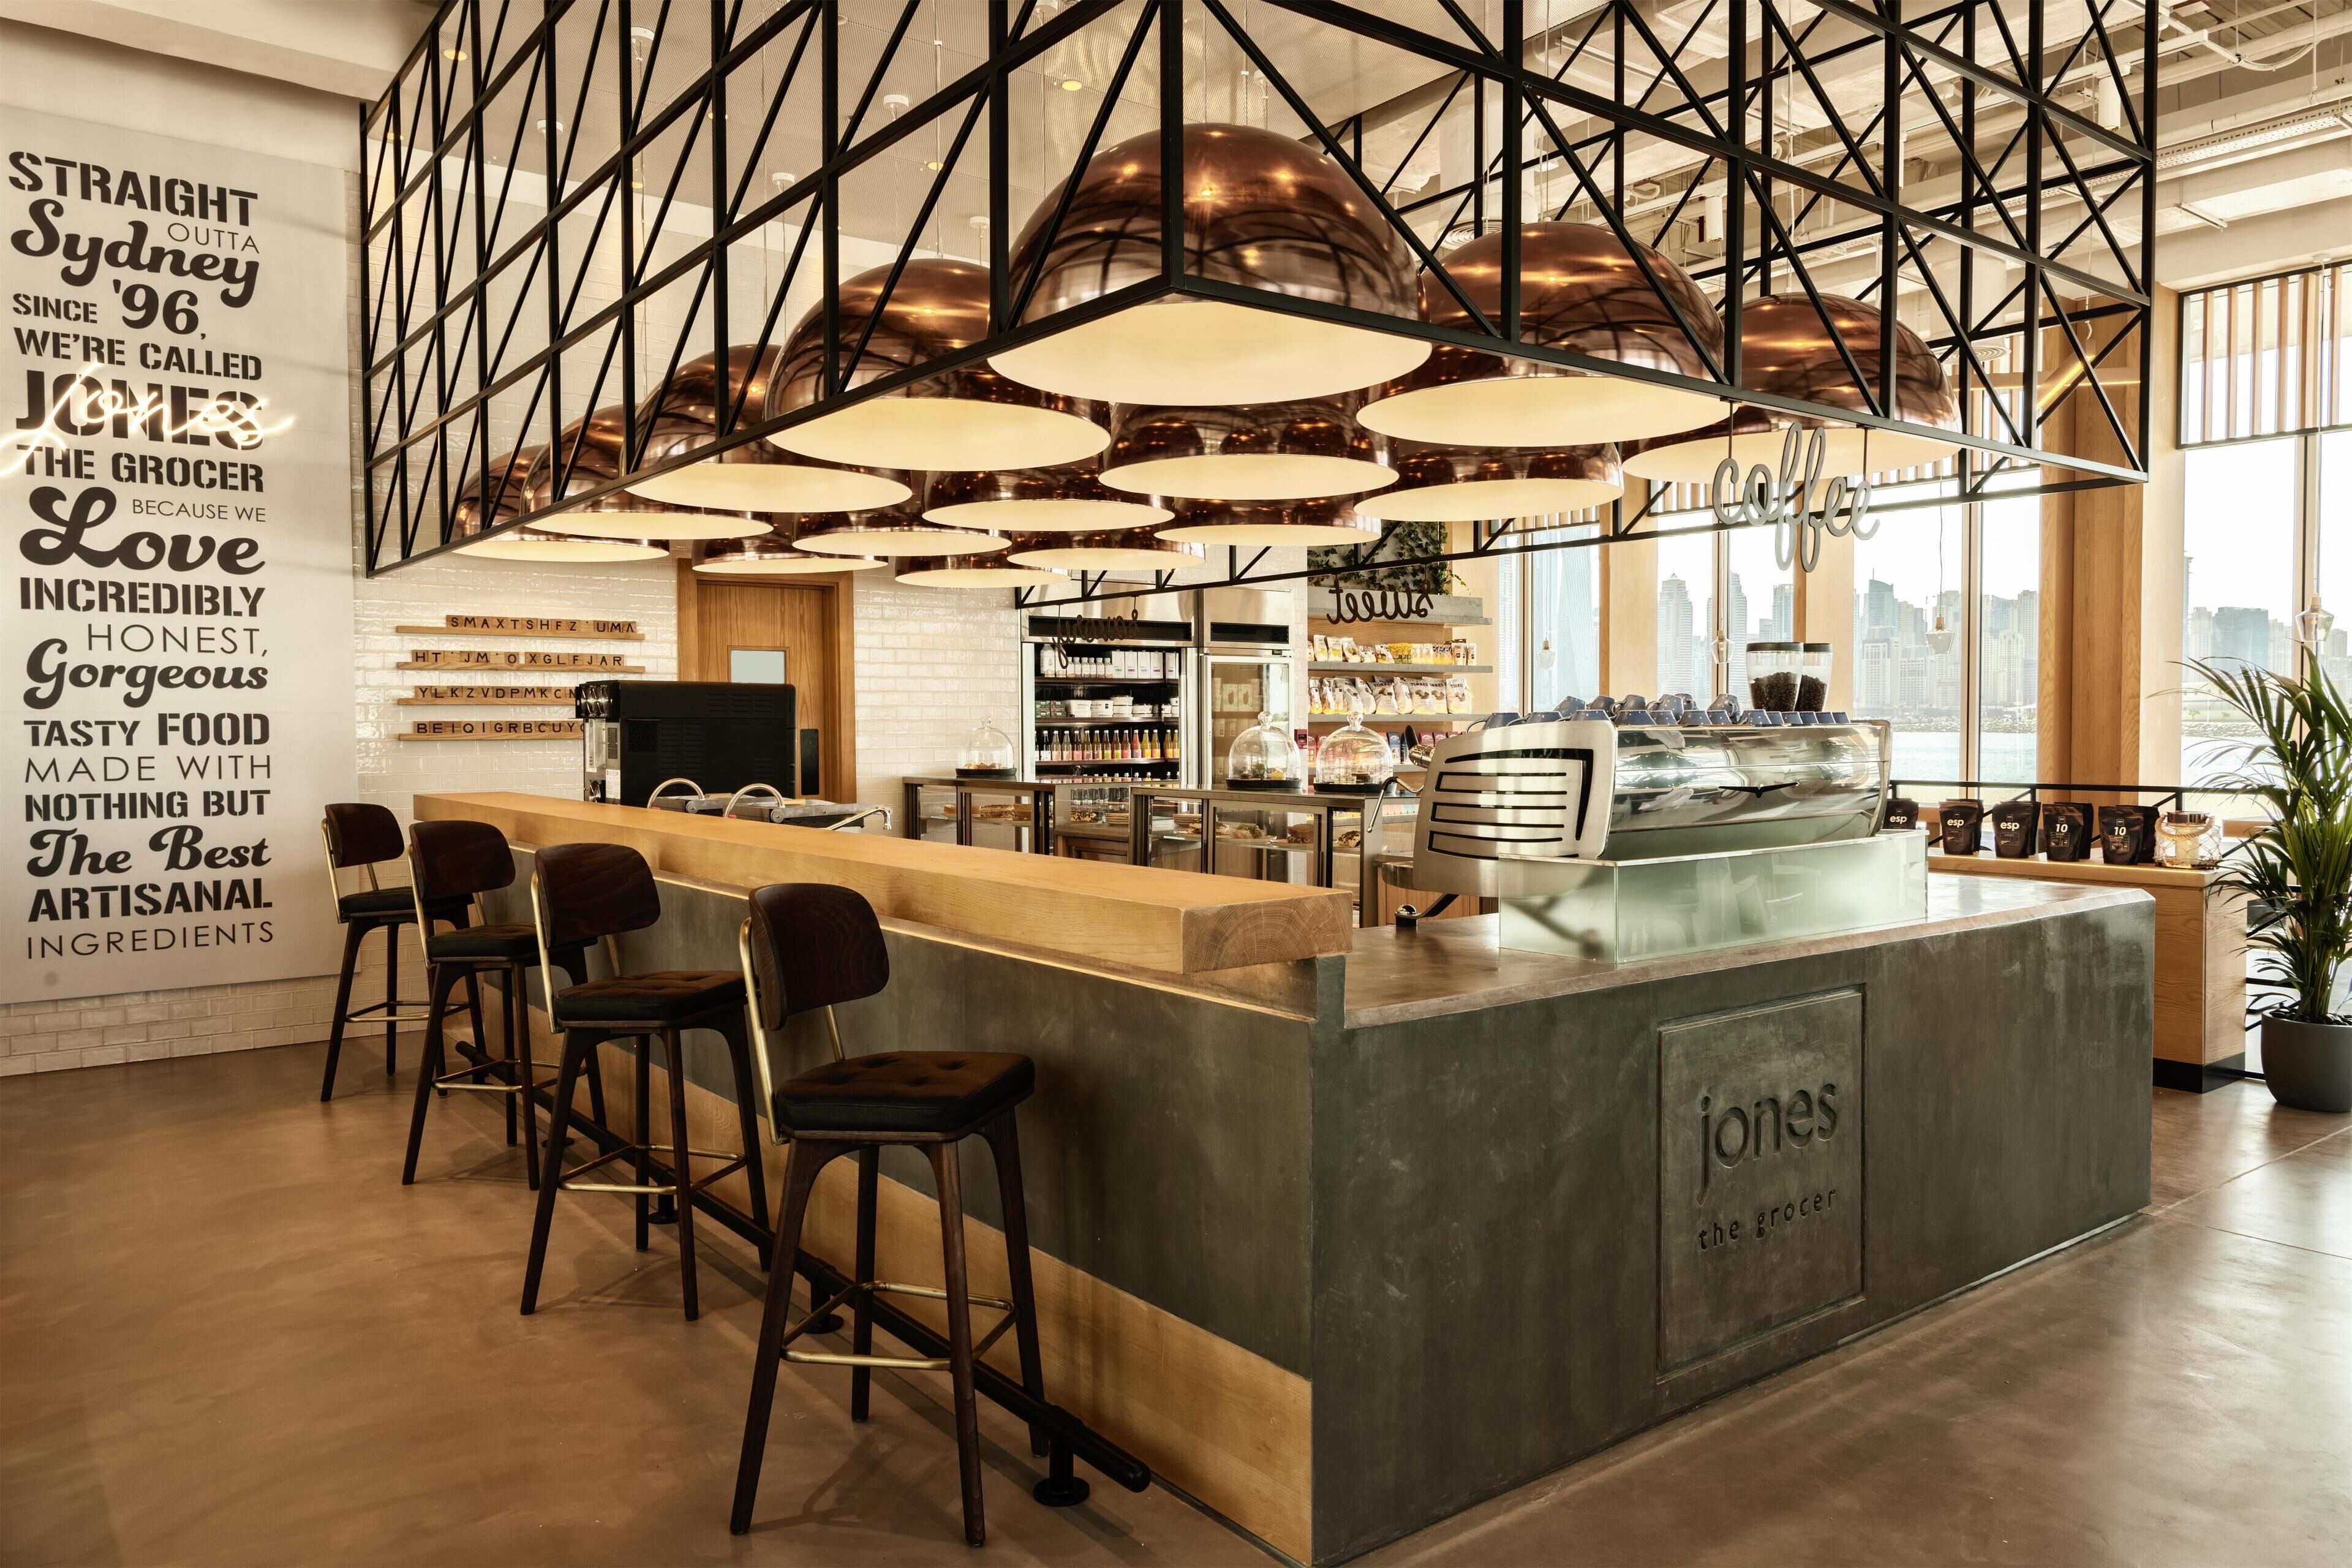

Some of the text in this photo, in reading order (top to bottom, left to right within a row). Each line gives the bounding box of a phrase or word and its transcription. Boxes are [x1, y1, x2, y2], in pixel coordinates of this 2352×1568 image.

[9, 152, 258, 227] STRAIGHT
[10, 198, 260, 308] Sydney
[167, 223, 260, 254] OUTTA
[12, 293, 97, 323] SINCE
[13, 327, 262, 380] WE'RE CALLED
[16, 370, 263, 450] JONES
[16, 444, 263, 492] THE GROCER
[133, 499, 266, 522] BECAUSE WE
[1713, 422, 1880, 573] coffee
[20, 486, 265, 575] Love
[20, 577, 265, 617] INCREDIBLY
[88, 623, 268, 657] HONEST,
[23, 638, 268, 709] Gorgeous
[23, 712, 270, 747] TASTY FOOD
[24, 755, 271, 783] MADE WITH
[25, 790, 271, 822] NOTHING BUT
[1890, 815, 1907, 824] esp
[1947, 819, 1964, 827] esp
[2000, 822, 2019, 831] esp
[2056, 824, 2068, 832] 10
[2114, 827, 2126, 835] 10
[26, 824, 272, 877] The Best
[28, 878, 273, 922] ARTISANAL
[28, 921, 274, 959] INGREDIENTS
[1696, 1084, 1837, 1207] jones
[1698, 1189, 1836, 1251] the grocer
